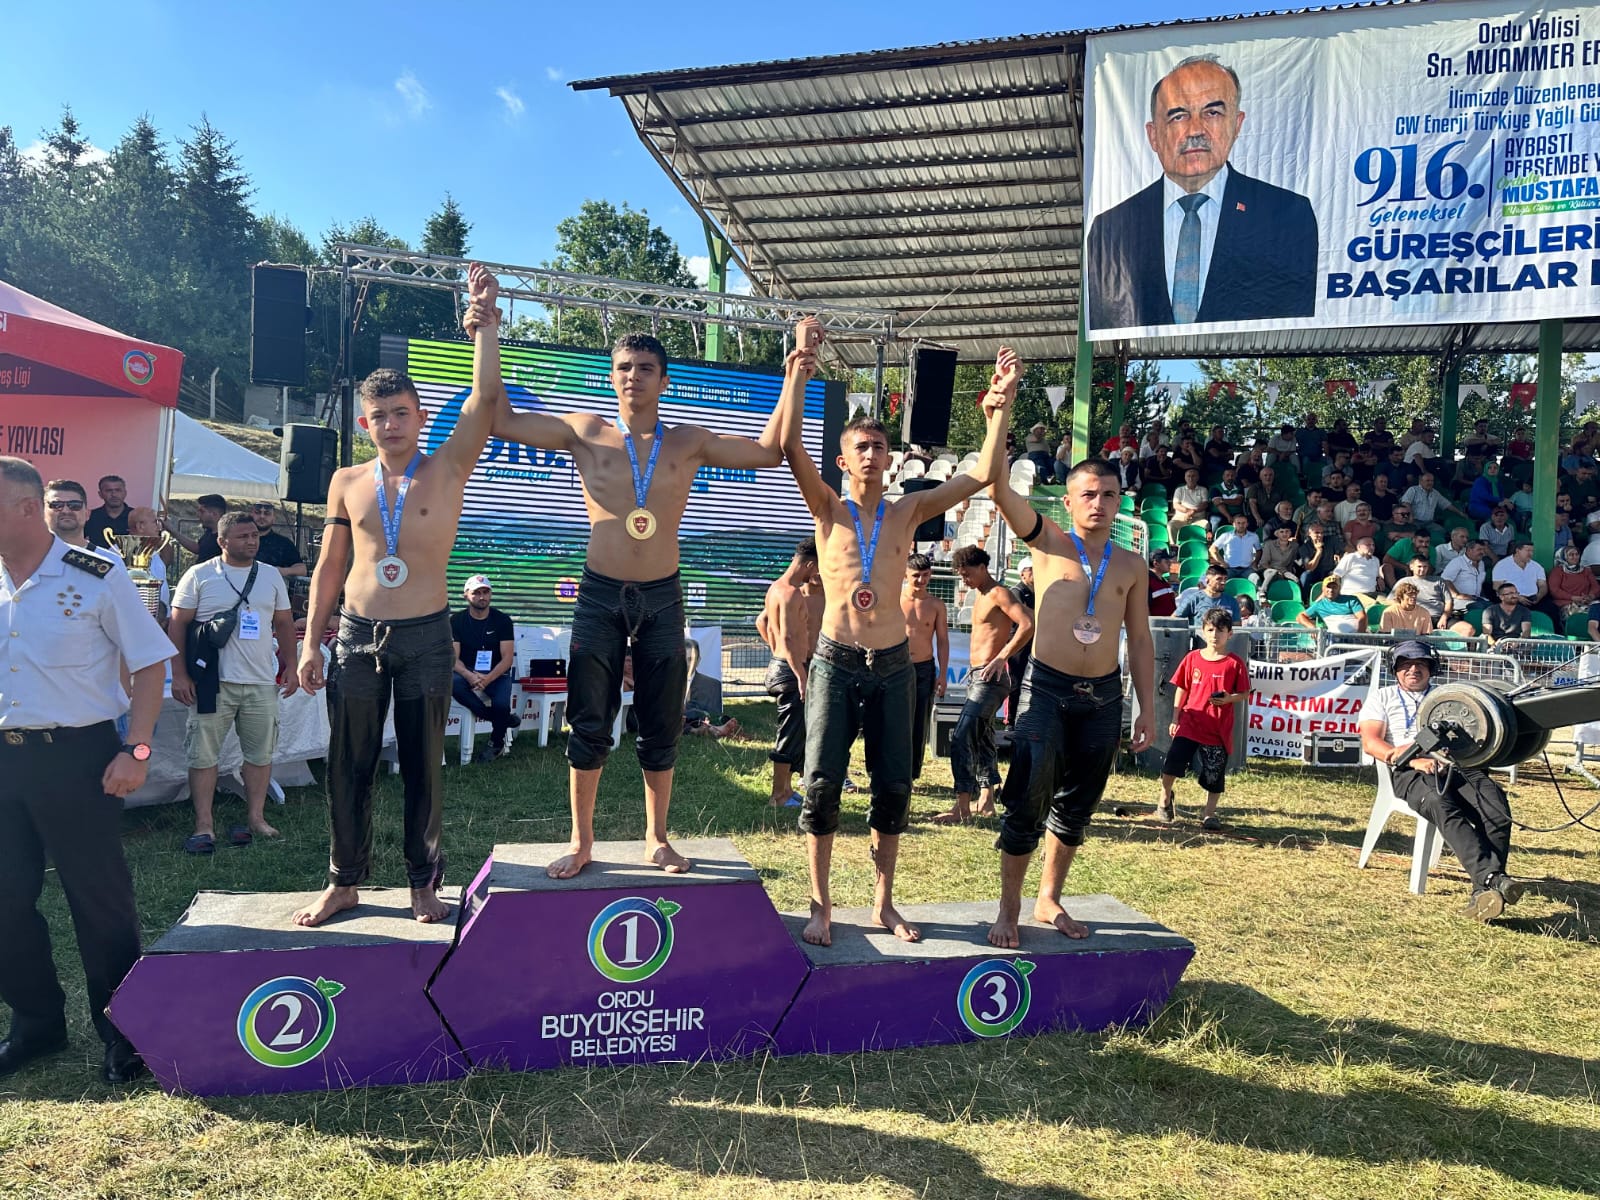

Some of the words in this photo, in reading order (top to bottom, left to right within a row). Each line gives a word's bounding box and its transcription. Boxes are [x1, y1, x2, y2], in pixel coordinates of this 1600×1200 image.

[1478, 21, 1522, 44] Ordu
[1529, 15, 1580, 41] Valisi
[1427, 53, 1458, 78] Sn.
[1466, 42, 1575, 76] MUAMMER
[1449, 86, 1508, 109] İlimizde
[1395, 116, 1419, 136] CW
[1425, 113, 1468, 135] Enerji
[1473, 111, 1530, 133] Türkiye
[1536, 105, 1574, 129] Yağlı
[1505, 133, 1573, 158] AYBASTI
[1354, 140, 1485, 207] 916.
[1503, 177, 1599, 204] MUSTAFA
[1369, 203, 1466, 228] Geleneksel
[1327, 261, 1578, 301] BAŞARILAR
[8, 425, 64, 456] YAYLASI
[1289, 667, 1341, 681] TOKAT
[618, 915, 643, 964] 1
[598, 990, 654, 1009] ORDU
[981, 975, 1008, 1020] 3
[269, 994, 304, 1046] 2
[541, 1007, 705, 1039] BÜYÜKŞEHİR
[571, 1034, 676, 1057] BELEDİYESİ
